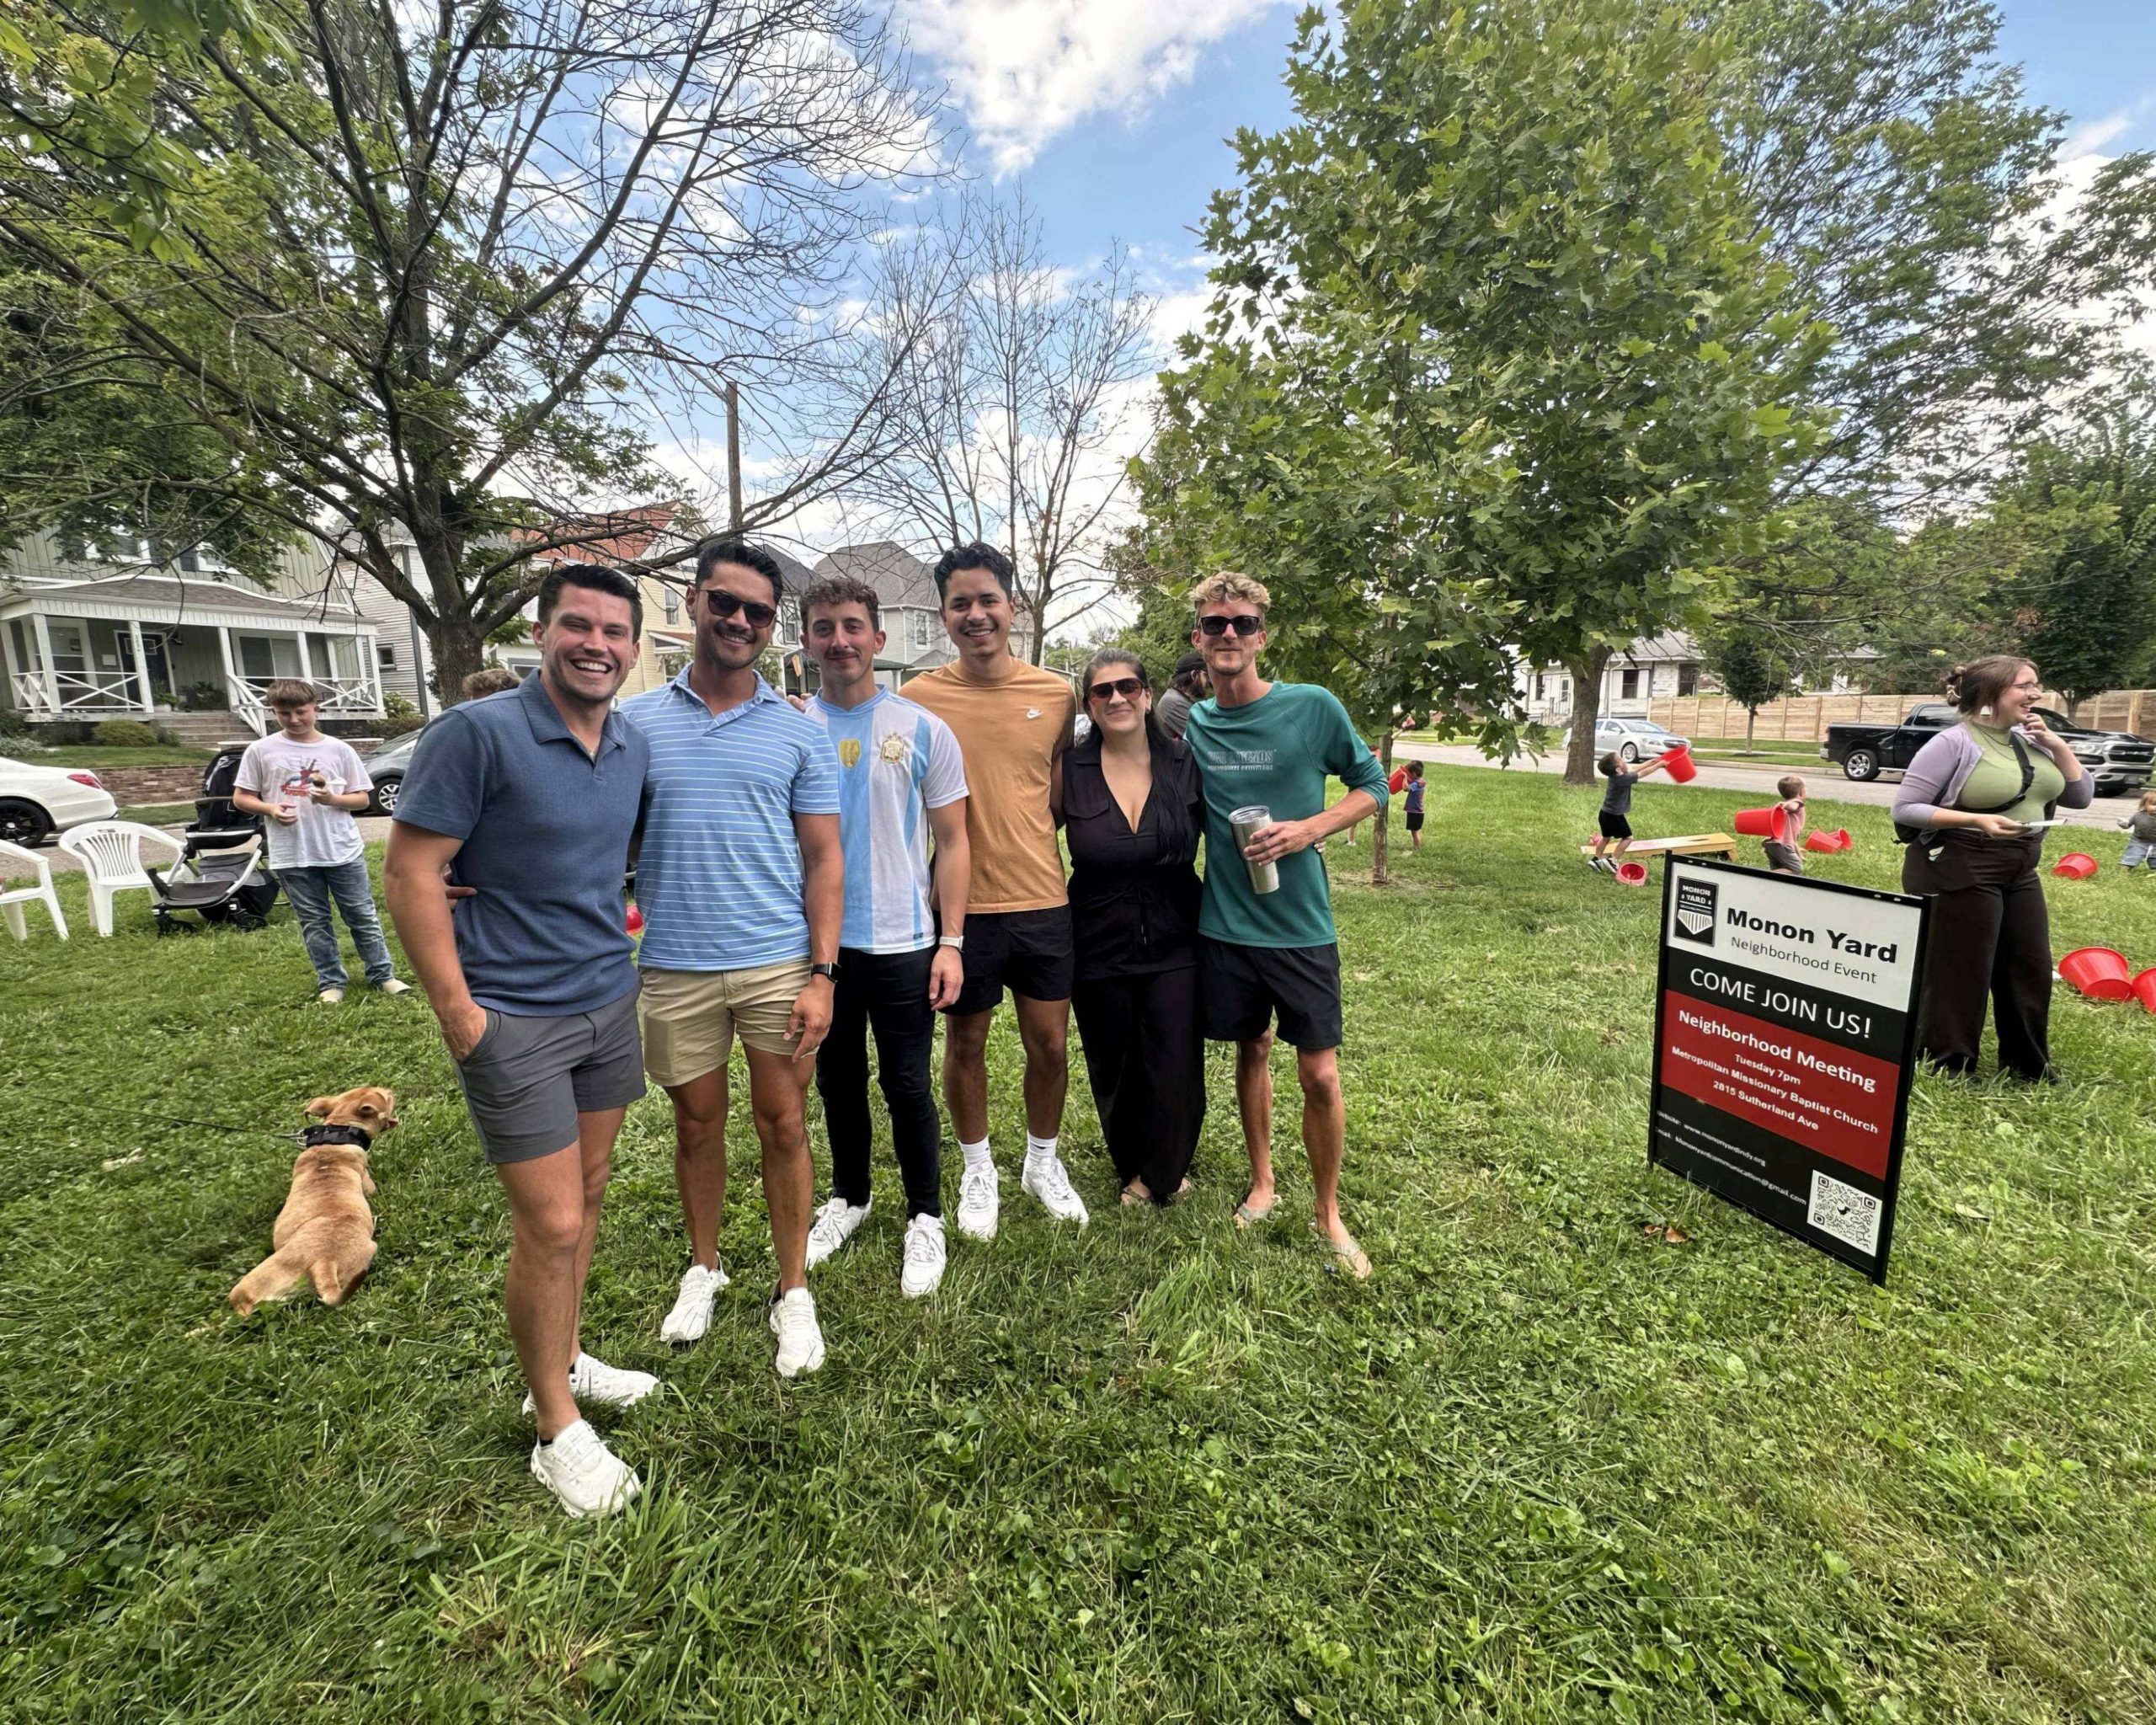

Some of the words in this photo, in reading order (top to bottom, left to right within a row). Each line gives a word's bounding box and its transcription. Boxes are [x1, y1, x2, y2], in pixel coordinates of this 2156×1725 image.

[1682, 885, 1711, 897] MONON
[1685, 894, 1706, 905] YARD
[1727, 907, 1814, 944] Monon
[1827, 929, 1897, 964] Yard
[1732, 936, 1829, 971] Neighborhood
[1834, 963, 1877, 984] Event
[1690, 969, 1756, 1003] COME
[1760, 989, 1817, 1022] JOIN
[1827, 1007, 1870, 1039] US!
[1679, 1010, 1791, 1060] Neighborhood
[1797, 1051, 1876, 1093] Meeting
[1735, 1054, 1775, 1077] Tuesday
[1777, 1069, 1801, 1086] 7pm
[1672, 1045, 1729, 1076] Metropolitan
[1731, 1070, 1787, 1099] Missionary
[1790, 1092, 1831, 1116] Baptist
[1833, 1108, 1879, 1135] Church
[1713, 1081, 1737, 1096] 2815
[1738, 1090, 1796, 1120] Sutherland
[1797, 1115, 1819, 1131] Ave
